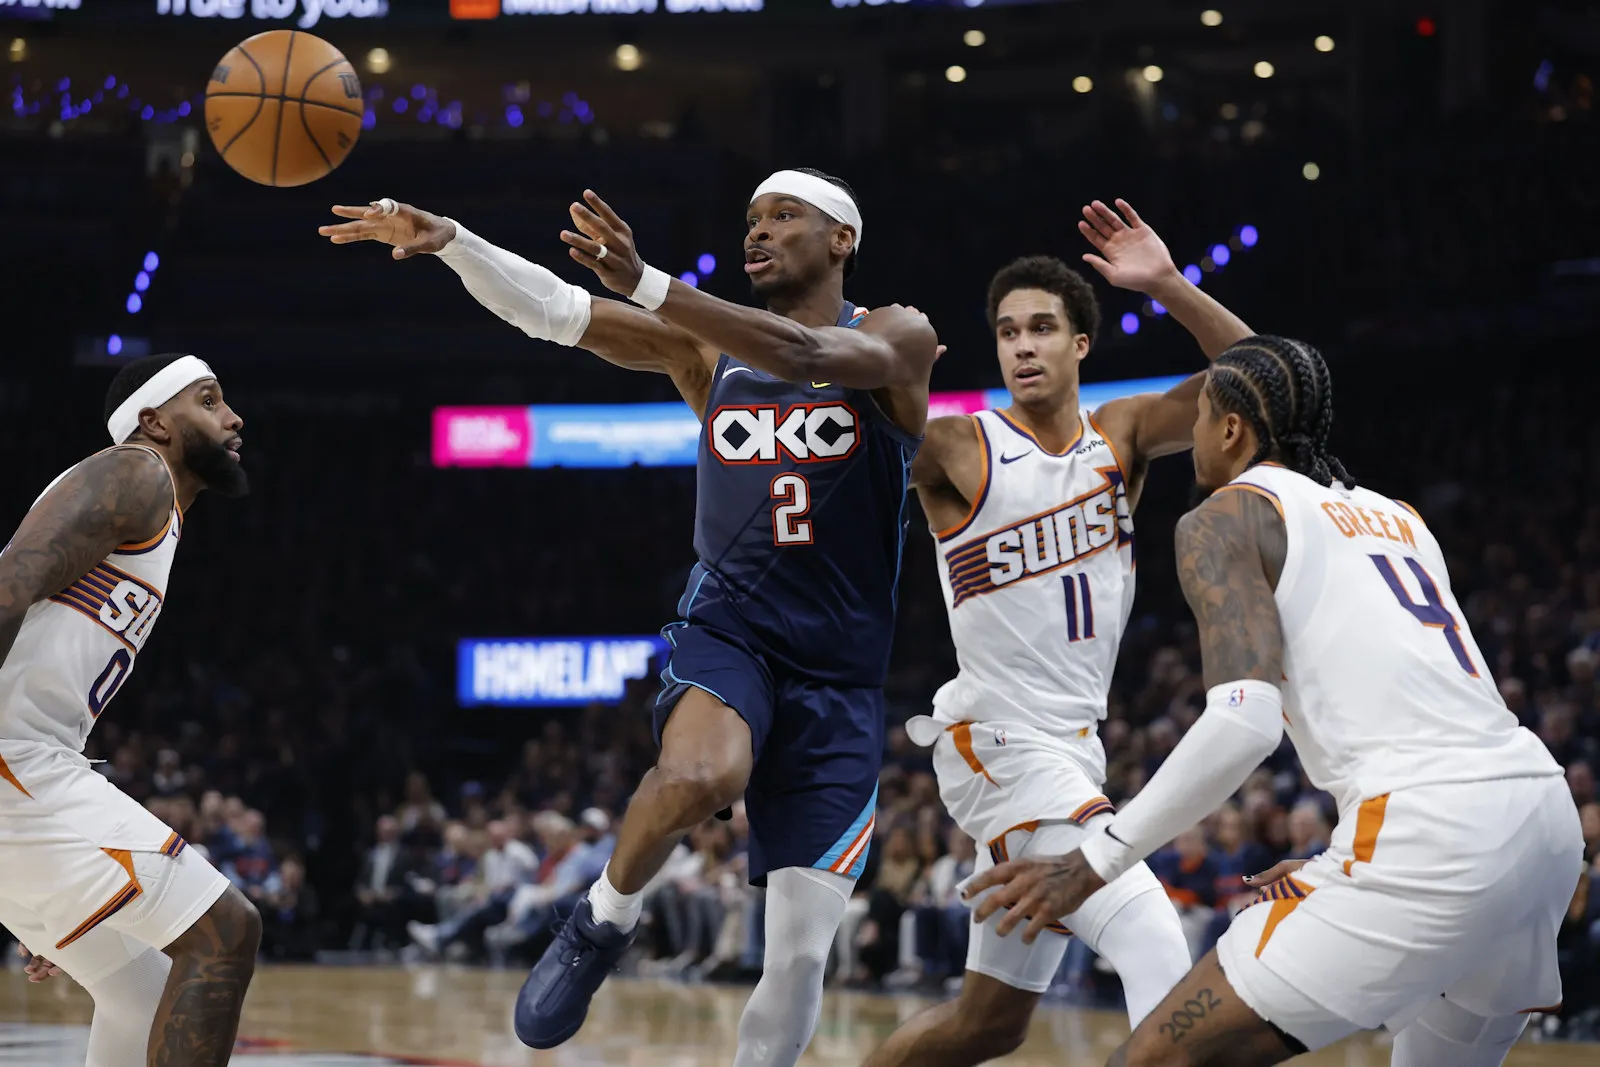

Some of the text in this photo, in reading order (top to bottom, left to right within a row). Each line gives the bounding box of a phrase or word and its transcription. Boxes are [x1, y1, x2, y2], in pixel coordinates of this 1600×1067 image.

[708, 401, 861, 464] OKC
[770, 472, 814, 546] 2
[986, 491, 1116, 586] SUNS
[1320, 501, 1418, 551] GREEN
[1061, 572, 1096, 642] 11
[1366, 553, 1481, 679] 4
[88, 648, 131, 719] 0
[1159, 988, 1222, 1044] 2002
